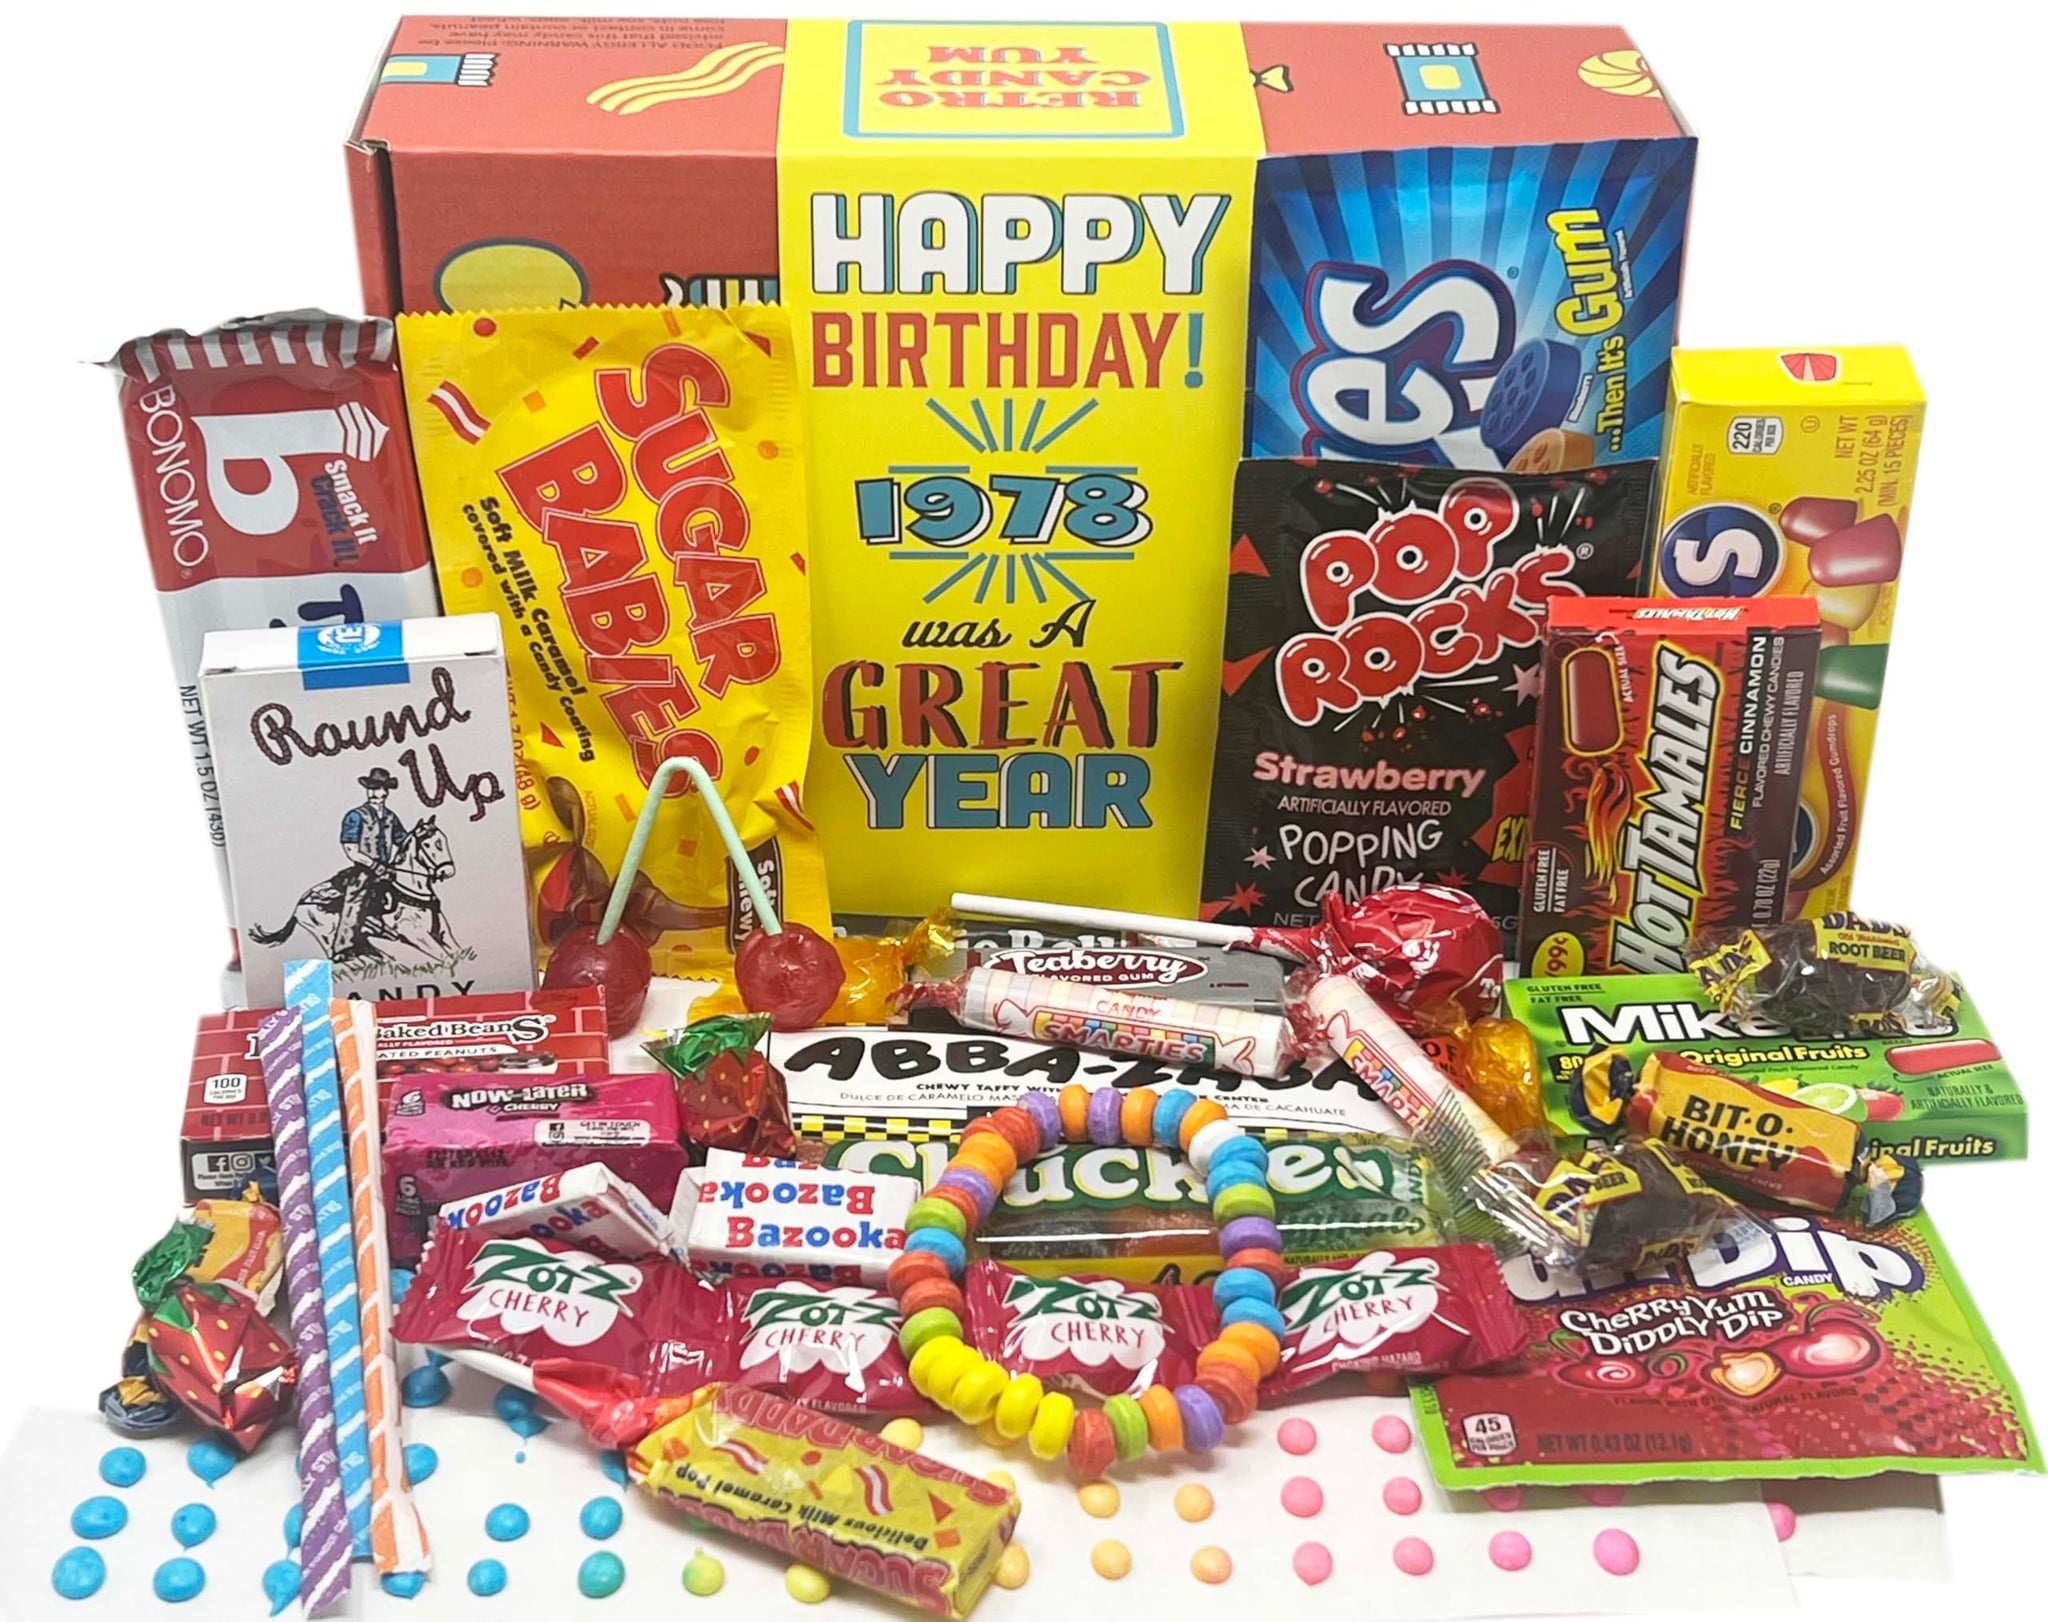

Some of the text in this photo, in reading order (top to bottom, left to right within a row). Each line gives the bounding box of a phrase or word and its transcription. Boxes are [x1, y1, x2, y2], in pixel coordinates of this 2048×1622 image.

[927, 46, 1100, 64] YUM
[875, 69, 1152, 86] CANDY
[878, 90, 1146, 108] RETRO
[811, 190, 1232, 295] HAPPY
[1545, 207, 1624, 337] Gum
[811, 311, 1204, 389] BIRTHDAY!
[1597, 334, 1626, 375] It's
[1732, 422, 1753, 450] 220
[1835, 415, 1859, 458] NET WT
[1863, 430, 1883, 452] (64
[1884, 414, 1912, 460] PIECES)
[139, 384, 209, 567] BONOMO
[1686, 444, 1704, 495] ARTIFICIALLY
[1701, 453, 1717, 496] FLAVORED
[1859, 450, 1880, 467] OZ
[1884, 460, 1901, 475] 15
[1855, 467, 1876, 494] 2.25
[310, 475, 340, 534] Crack
[325, 459, 378, 545] Smack It
[594, 342, 782, 701] SUGAR
[854, 473, 1153, 547] 1978
[1300, 477, 1519, 632] POP
[480, 496, 588, 697] Soft Milk Caramel
[495, 421, 724, 799] BABIES
[462, 503, 503, 575] covered
[500, 579, 526, 629] with
[520, 623, 532, 636] a
[528, 639, 562, 692] Candy
[559, 696, 596, 763] Coating
[901, 599, 1098, 649] was A
[1276, 542, 1586, 727] ROCKS
[1614, 645, 1634, 703] ACTUAL SIZE
[250, 666, 471, 766] Round
[821, 660, 1184, 750] GREAT
[1739, 636, 1767, 755] CINNAMON
[180, 685, 201, 718] NET
[194, 720, 211, 751] WT
[1752, 636, 1785, 808] FLAVORED CHEWY CANDIES
[1774, 670, 1805, 776] ARTIFICIALLY FLAVORED
[399, 743, 505, 822] Up
[843, 753, 1154, 830] YEAR
[1252, 750, 1486, 798] Strawberry
[1819, 713, 1850, 876] Assorted Fruit Flavored Gumdrops
[1277, 794, 1452, 817] ARTIFICIALLY FLAVORED
[1278, 819, 1443, 867] POPPING
[1533, 849, 1550, 913] GLUTEN FREE
[1553, 869, 1569, 913] FAT FREE
[1273, 911, 1317, 928] NET
[985, 950, 1187, 984] Teaberry
[1829, 941, 1906, 962] ROOT BEER
[348, 980, 476, 1000] ANDY
[1118, 973, 1154, 982] GUM
[1527, 983, 1602, 993] GLUTEN FREE
[1095, 1000, 1163, 1020] CANDY
[1530, 996, 1555, 1004] FAT
[1041, 1022, 1206, 1063] SMARTIES
[1557, 1001, 1793, 1047] Mike
[424, 1047, 498, 1057] PEANUTS
[1678, 1043, 1870, 1068] Original Fruits
[212, 1077, 241, 1089] 100
[916, 1083, 1269, 1103] CHEWY TAFFY CENTER
[1925, 1084, 1985, 1096] NATURALLY
[1937, 1068, 1974, 1079] ACTUAL
[503, 1102, 559, 1112] CHERRY
[840, 1092, 885, 1102] DULCE
[886, 1093, 904, 1102] DE
[907, 1092, 985, 1102] CARAMELO
[1244, 1103, 1262, 1112] DE
[1266, 1104, 1347, 1117] CACAHUATE
[1976, 1093, 2024, 1106] FLAVORED
[1660, 1116, 1795, 1172] HONEY
[1926, 1137, 1994, 1158] Fruits
[398, 1176, 417, 1196] 6
[444, 1171, 563, 1230] Bazook
[698, 1181, 875, 1215] Bazooka
[726, 1216, 907, 1249] Bazooka
[1686, 1217, 1914, 1299] Dip
[461, 1243, 634, 1318] ZOTZ
[1003, 1276, 1164, 1325] ZOTZ
[1281, 1262, 1444, 1318] ZOTZ
[1782, 1273, 1833, 1287] CANDY
[488, 1287, 591, 1328] CHERRY
[1322, 1295, 1414, 1333] CHERRY
[765, 1327, 866, 1350] CHERRY
[1050, 1319, 1147, 1348] CHERRY
[1475, 1416, 1501, 1434] 45
[1537, 1434, 1563, 1452] NET
[1566, 1433, 1588, 1452] WT
[1624, 1432, 1643, 1452] OZ
[675, 1463, 710, 1490] Pop
[712, 1479, 794, 1517] Caramel
[798, 1504, 841, 1529] Milk
[844, 1515, 929, 1551] Delicious
